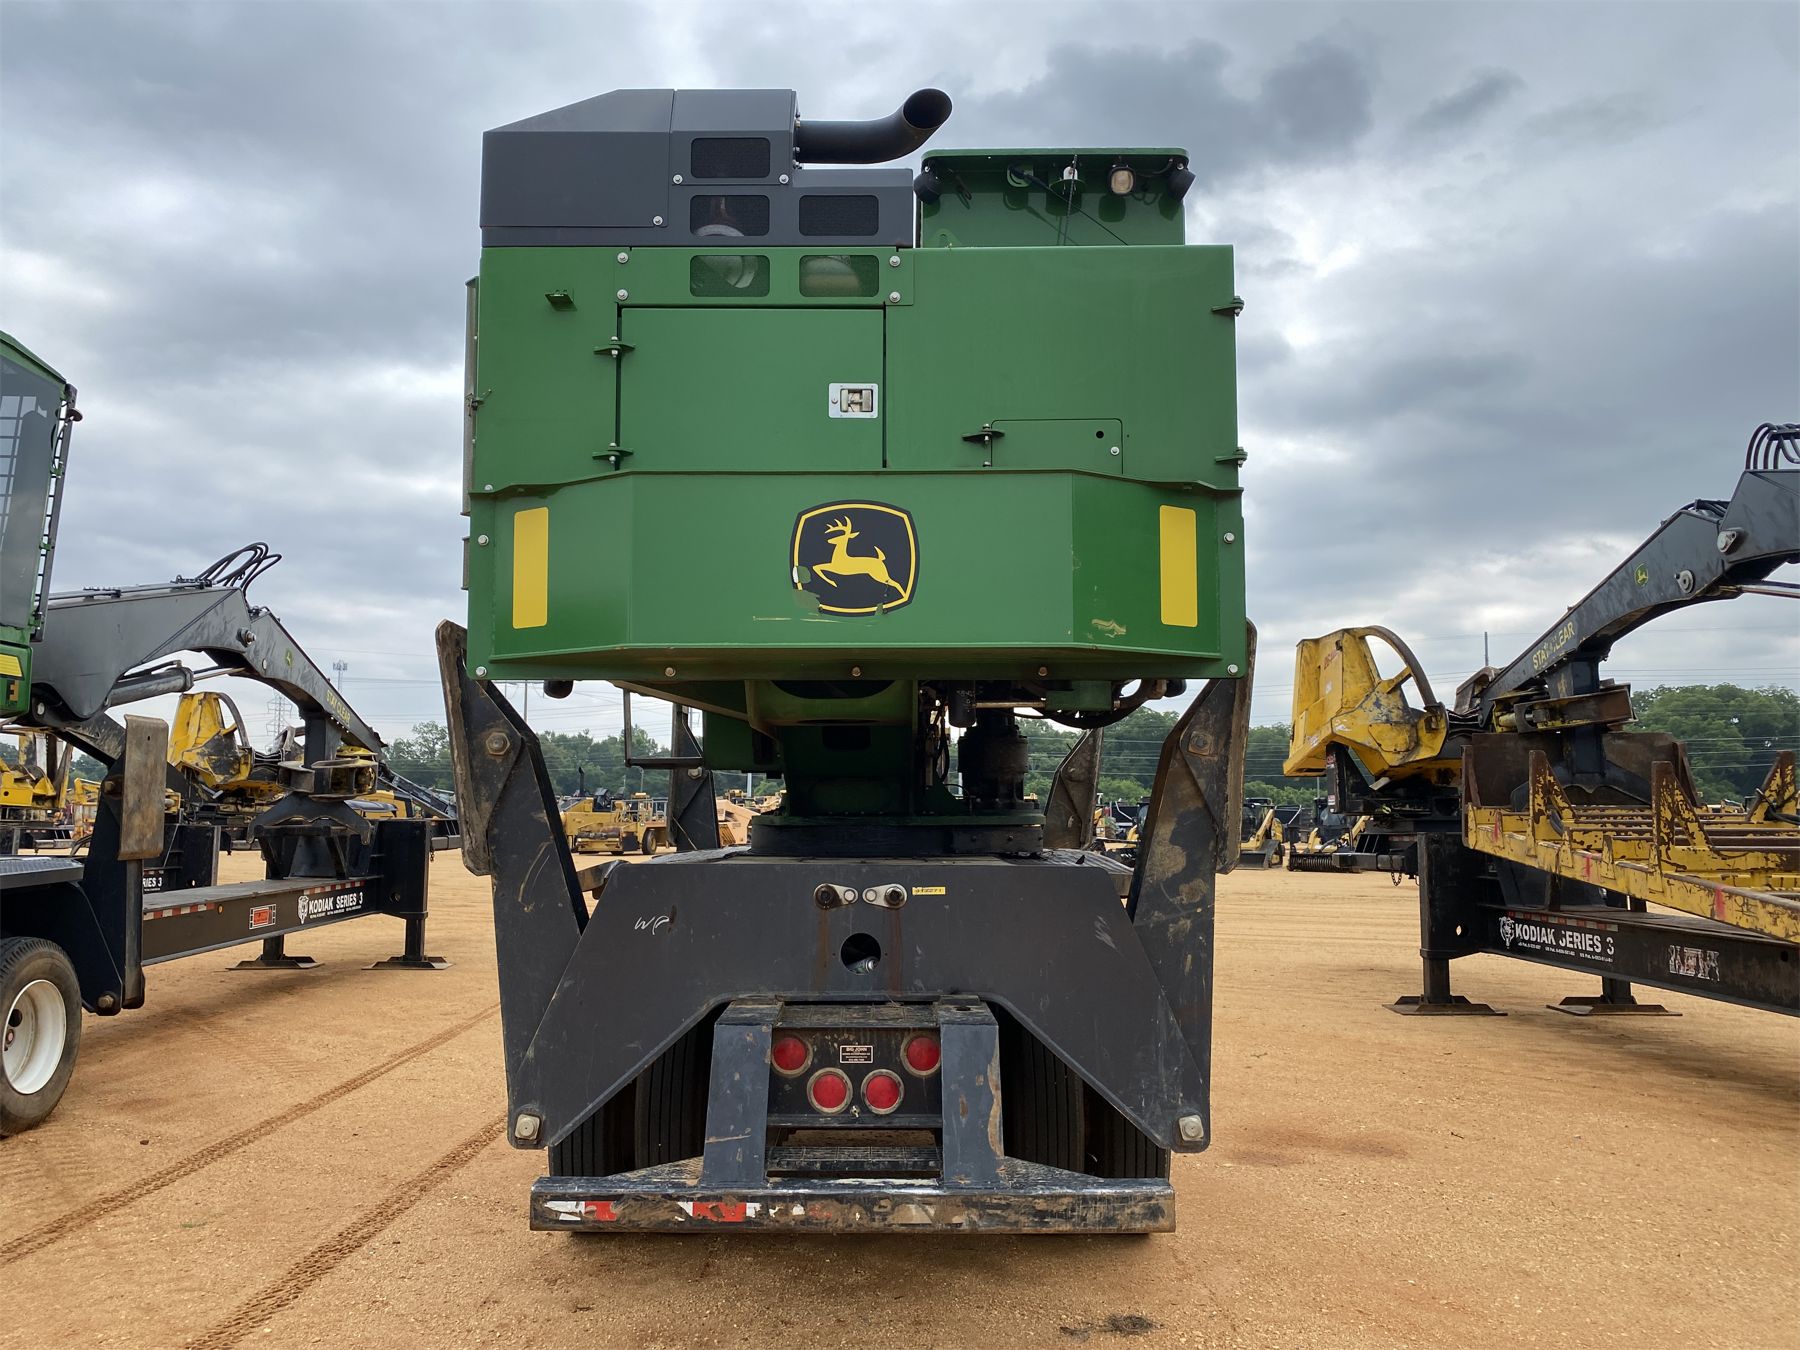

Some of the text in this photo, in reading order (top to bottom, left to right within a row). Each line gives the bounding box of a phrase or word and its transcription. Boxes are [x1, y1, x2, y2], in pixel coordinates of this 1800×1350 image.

[157, 877, 163, 887] 3
[309, 897, 334, 914] KODIAK
[336, 893, 357, 909] SERIES
[359, 892, 364, 905] 3
[1515, 923, 1615, 955] KODIAK SERIES 3
